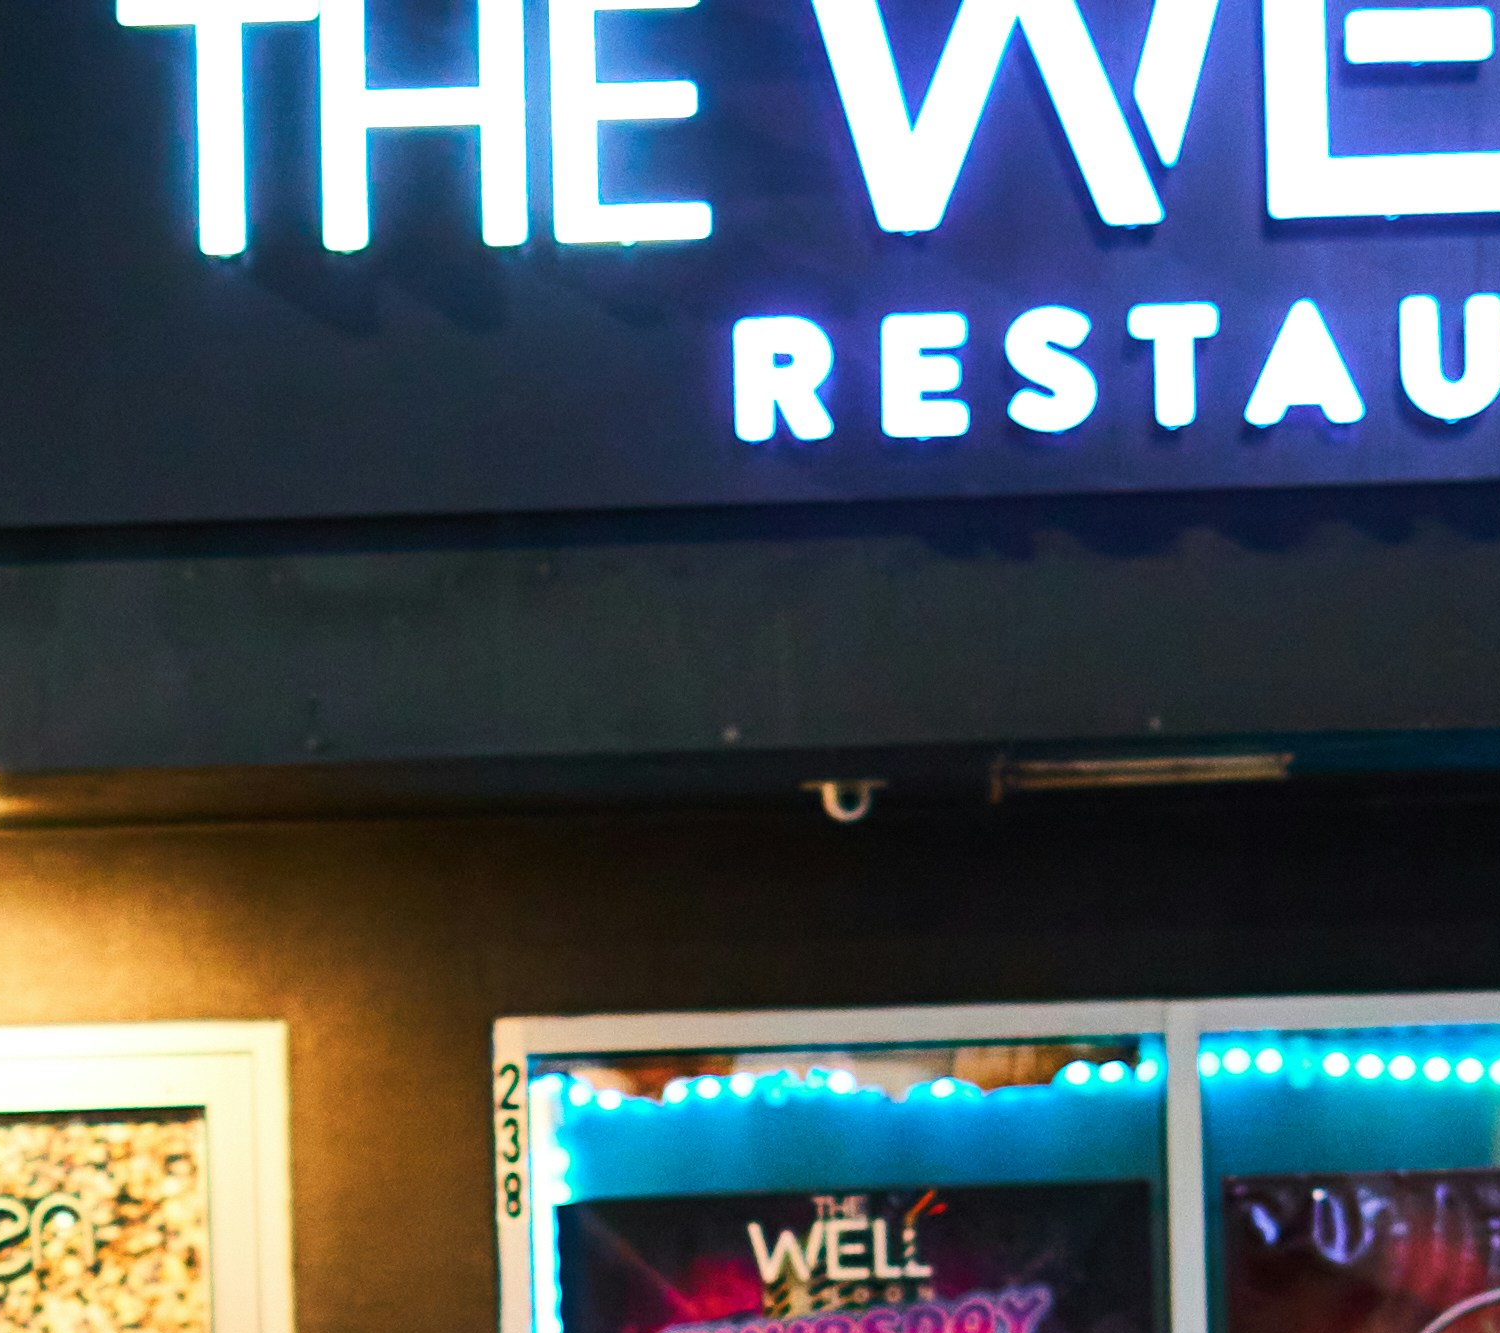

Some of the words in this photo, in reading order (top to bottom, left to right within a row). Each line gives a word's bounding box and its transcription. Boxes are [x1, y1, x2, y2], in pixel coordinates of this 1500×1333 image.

[117, 0, 712, 256] THE
[499, 1063, 522, 1219] 238
[746, 1217, 933, 1283] WELL
[812, 1195, 868, 1218] THE
